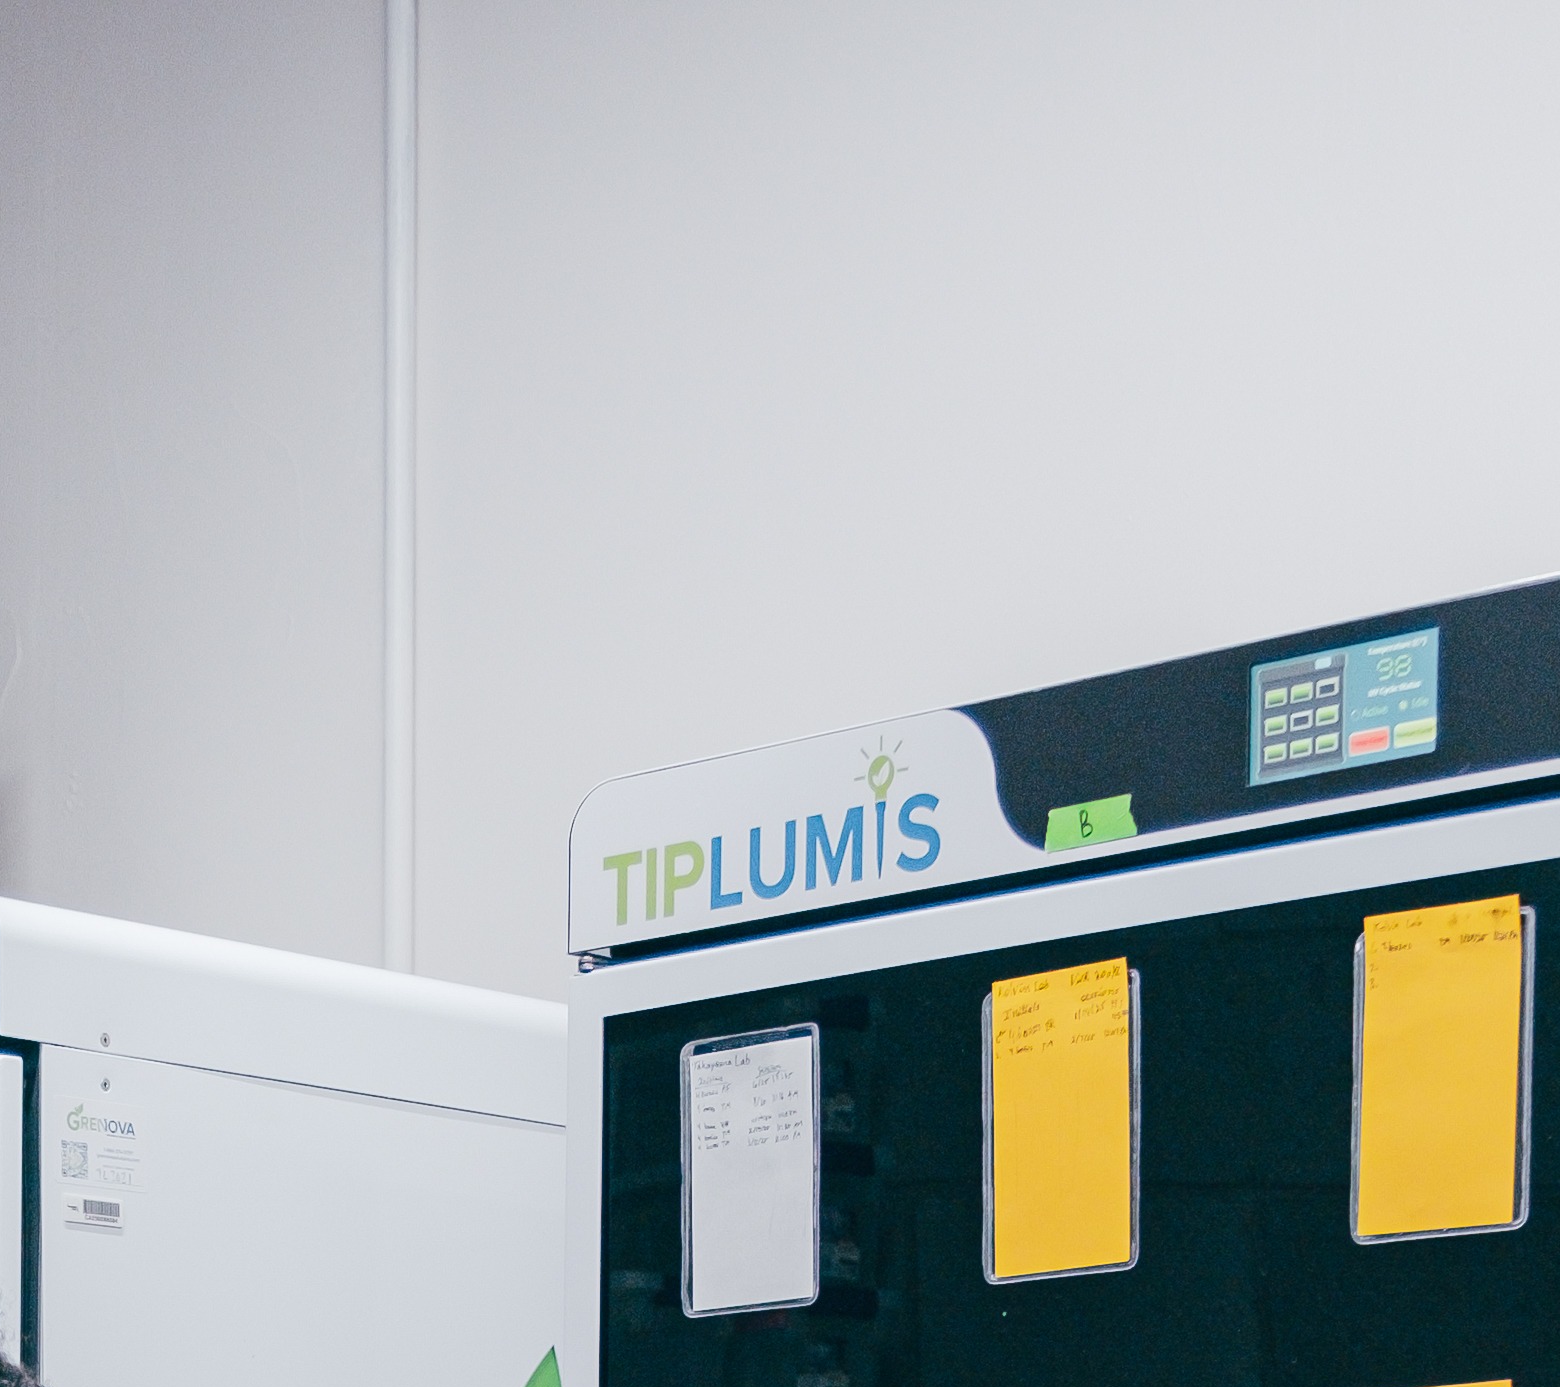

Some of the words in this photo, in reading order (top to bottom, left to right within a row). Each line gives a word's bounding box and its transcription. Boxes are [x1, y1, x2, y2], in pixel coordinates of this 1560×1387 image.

[1375, 653, 1413, 682] 98
[1077, 808, 1096, 839] B
[602, 792, 941, 927] TIPLUMIS
[66, 1108, 137, 1137] GRENOVA
